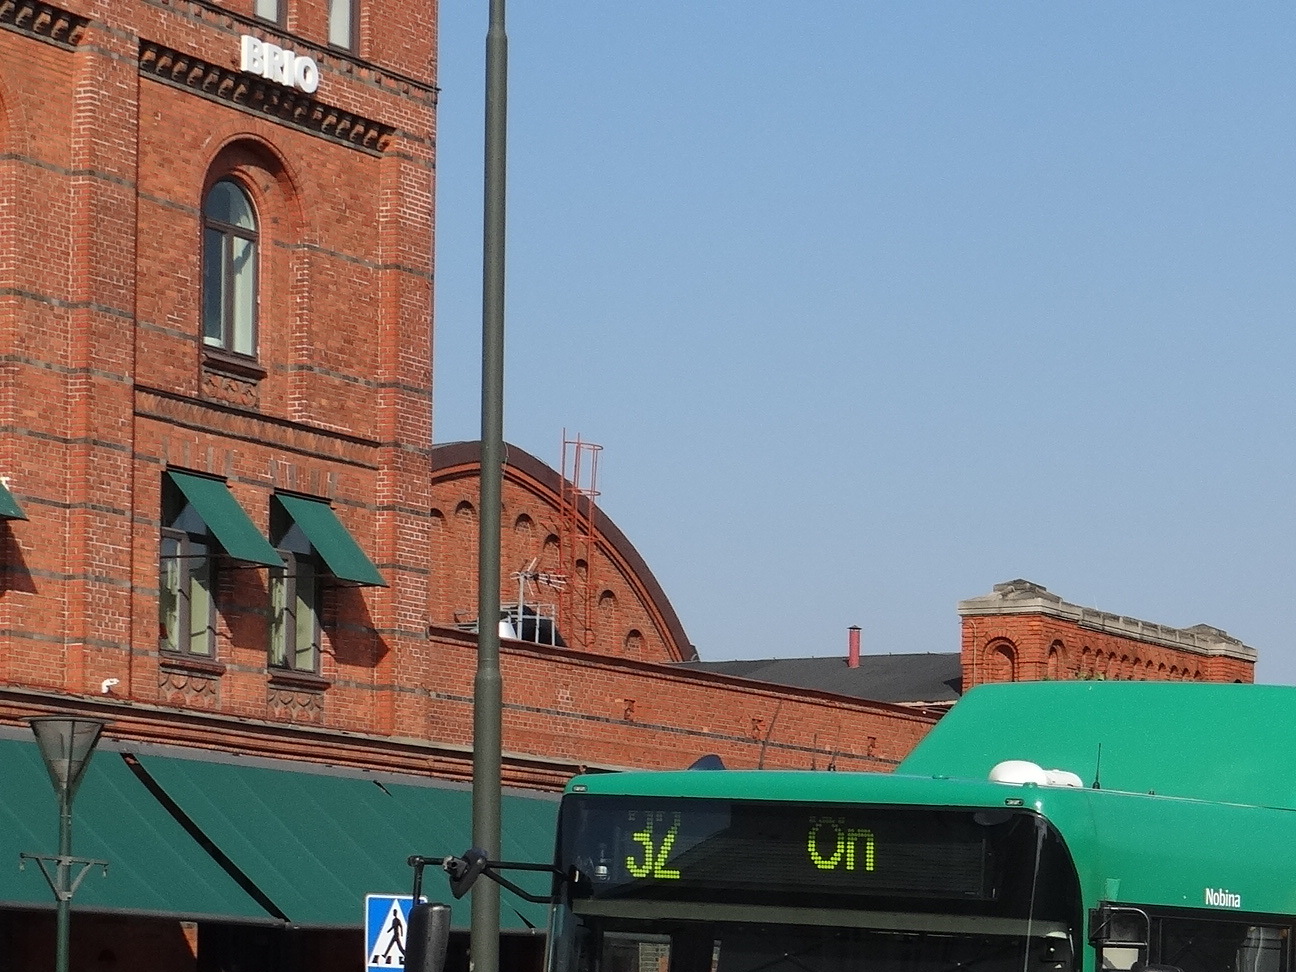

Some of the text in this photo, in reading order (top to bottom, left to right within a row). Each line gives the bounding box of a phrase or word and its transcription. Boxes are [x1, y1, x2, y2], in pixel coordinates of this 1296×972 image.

[240, 34, 319, 94] BRIO
[626, 811, 680, 879] 32
[1205, 888, 1241, 908] Nobina
